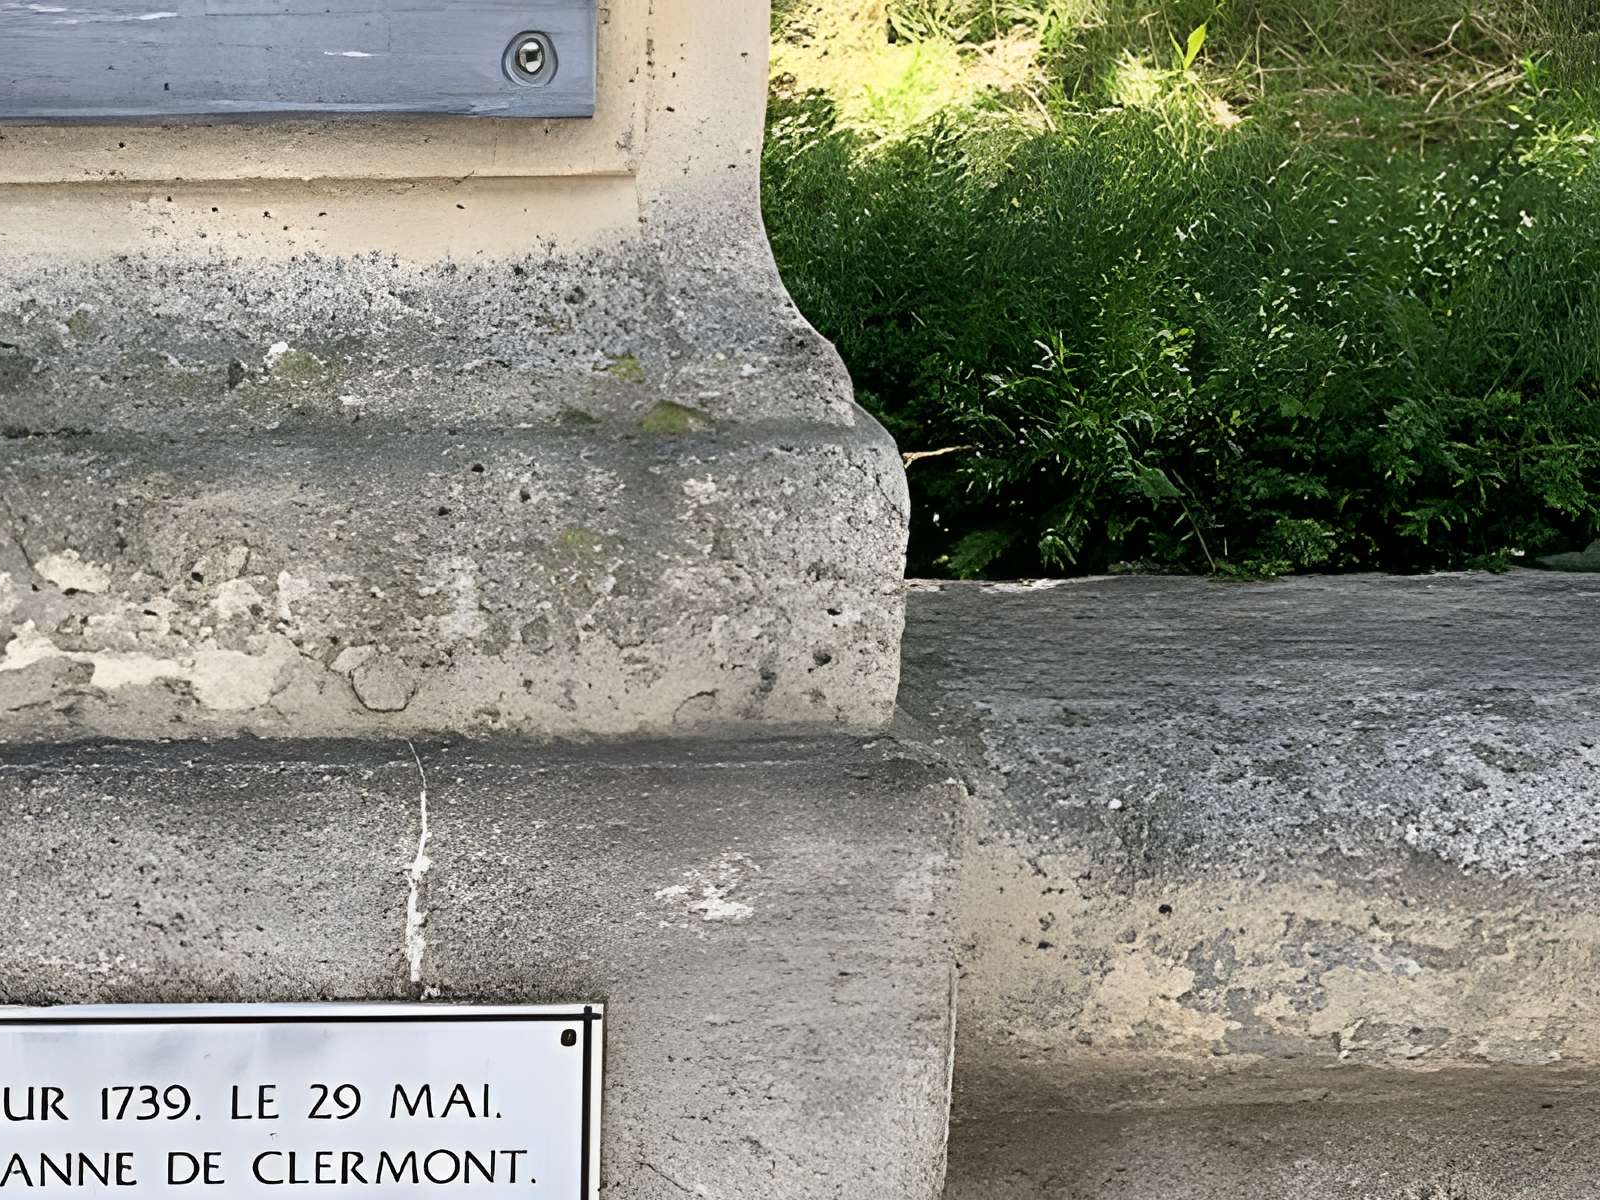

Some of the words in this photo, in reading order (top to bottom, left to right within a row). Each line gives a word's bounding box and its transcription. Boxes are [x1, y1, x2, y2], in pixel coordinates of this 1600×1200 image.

[231, 1084, 280, 1120] LE
[307, 1083, 362, 1120] 29
[0, 1152, 138, 1188] ANNE
[167, 1151, 225, 1185] DE
